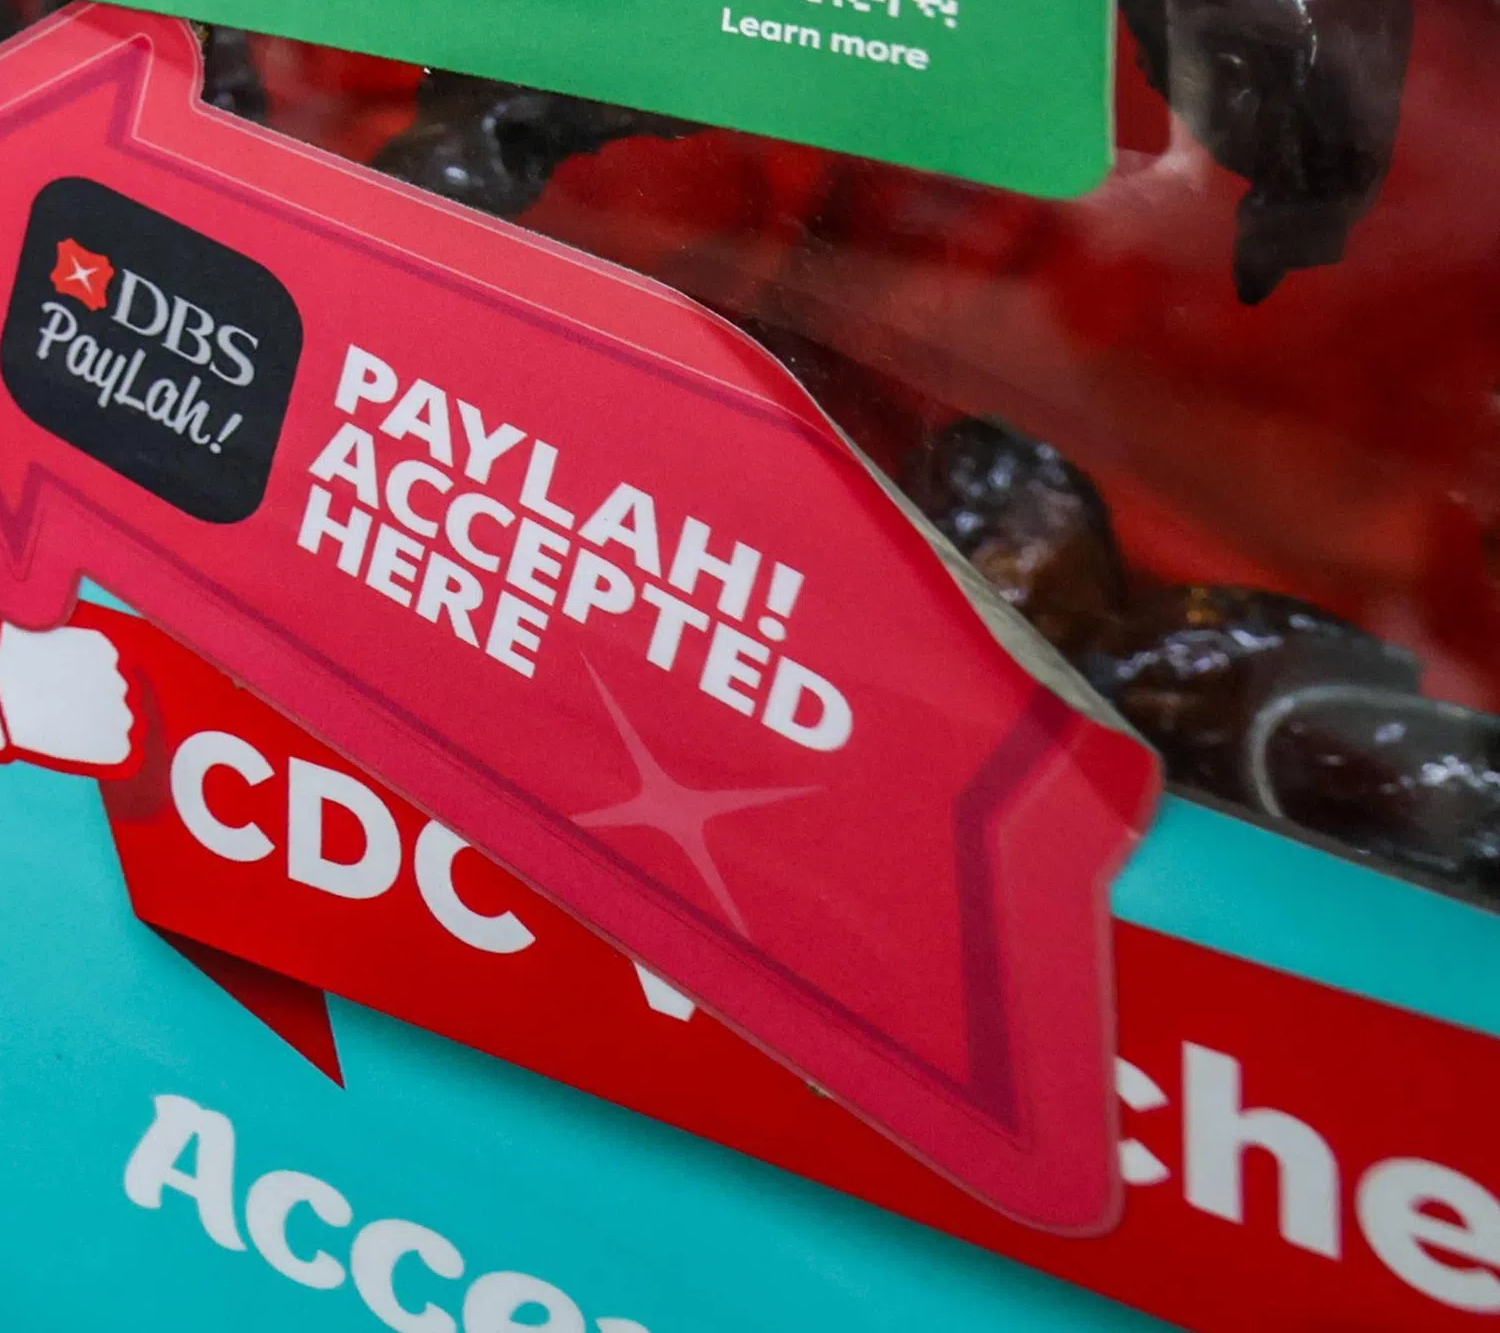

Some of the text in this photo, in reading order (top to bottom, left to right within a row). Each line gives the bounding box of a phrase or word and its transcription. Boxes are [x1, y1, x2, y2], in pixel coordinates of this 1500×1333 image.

[721, 7, 930, 71] Learn more
[39, 301, 243, 455] PayLah!
[111, 268, 260, 389] DBS
[296, 485, 549, 679] HERE
[308, 422, 854, 753] ACCEPTED
[334, 344, 805, 642] PAYLAH!
[169, 730, 536, 954] CDC
